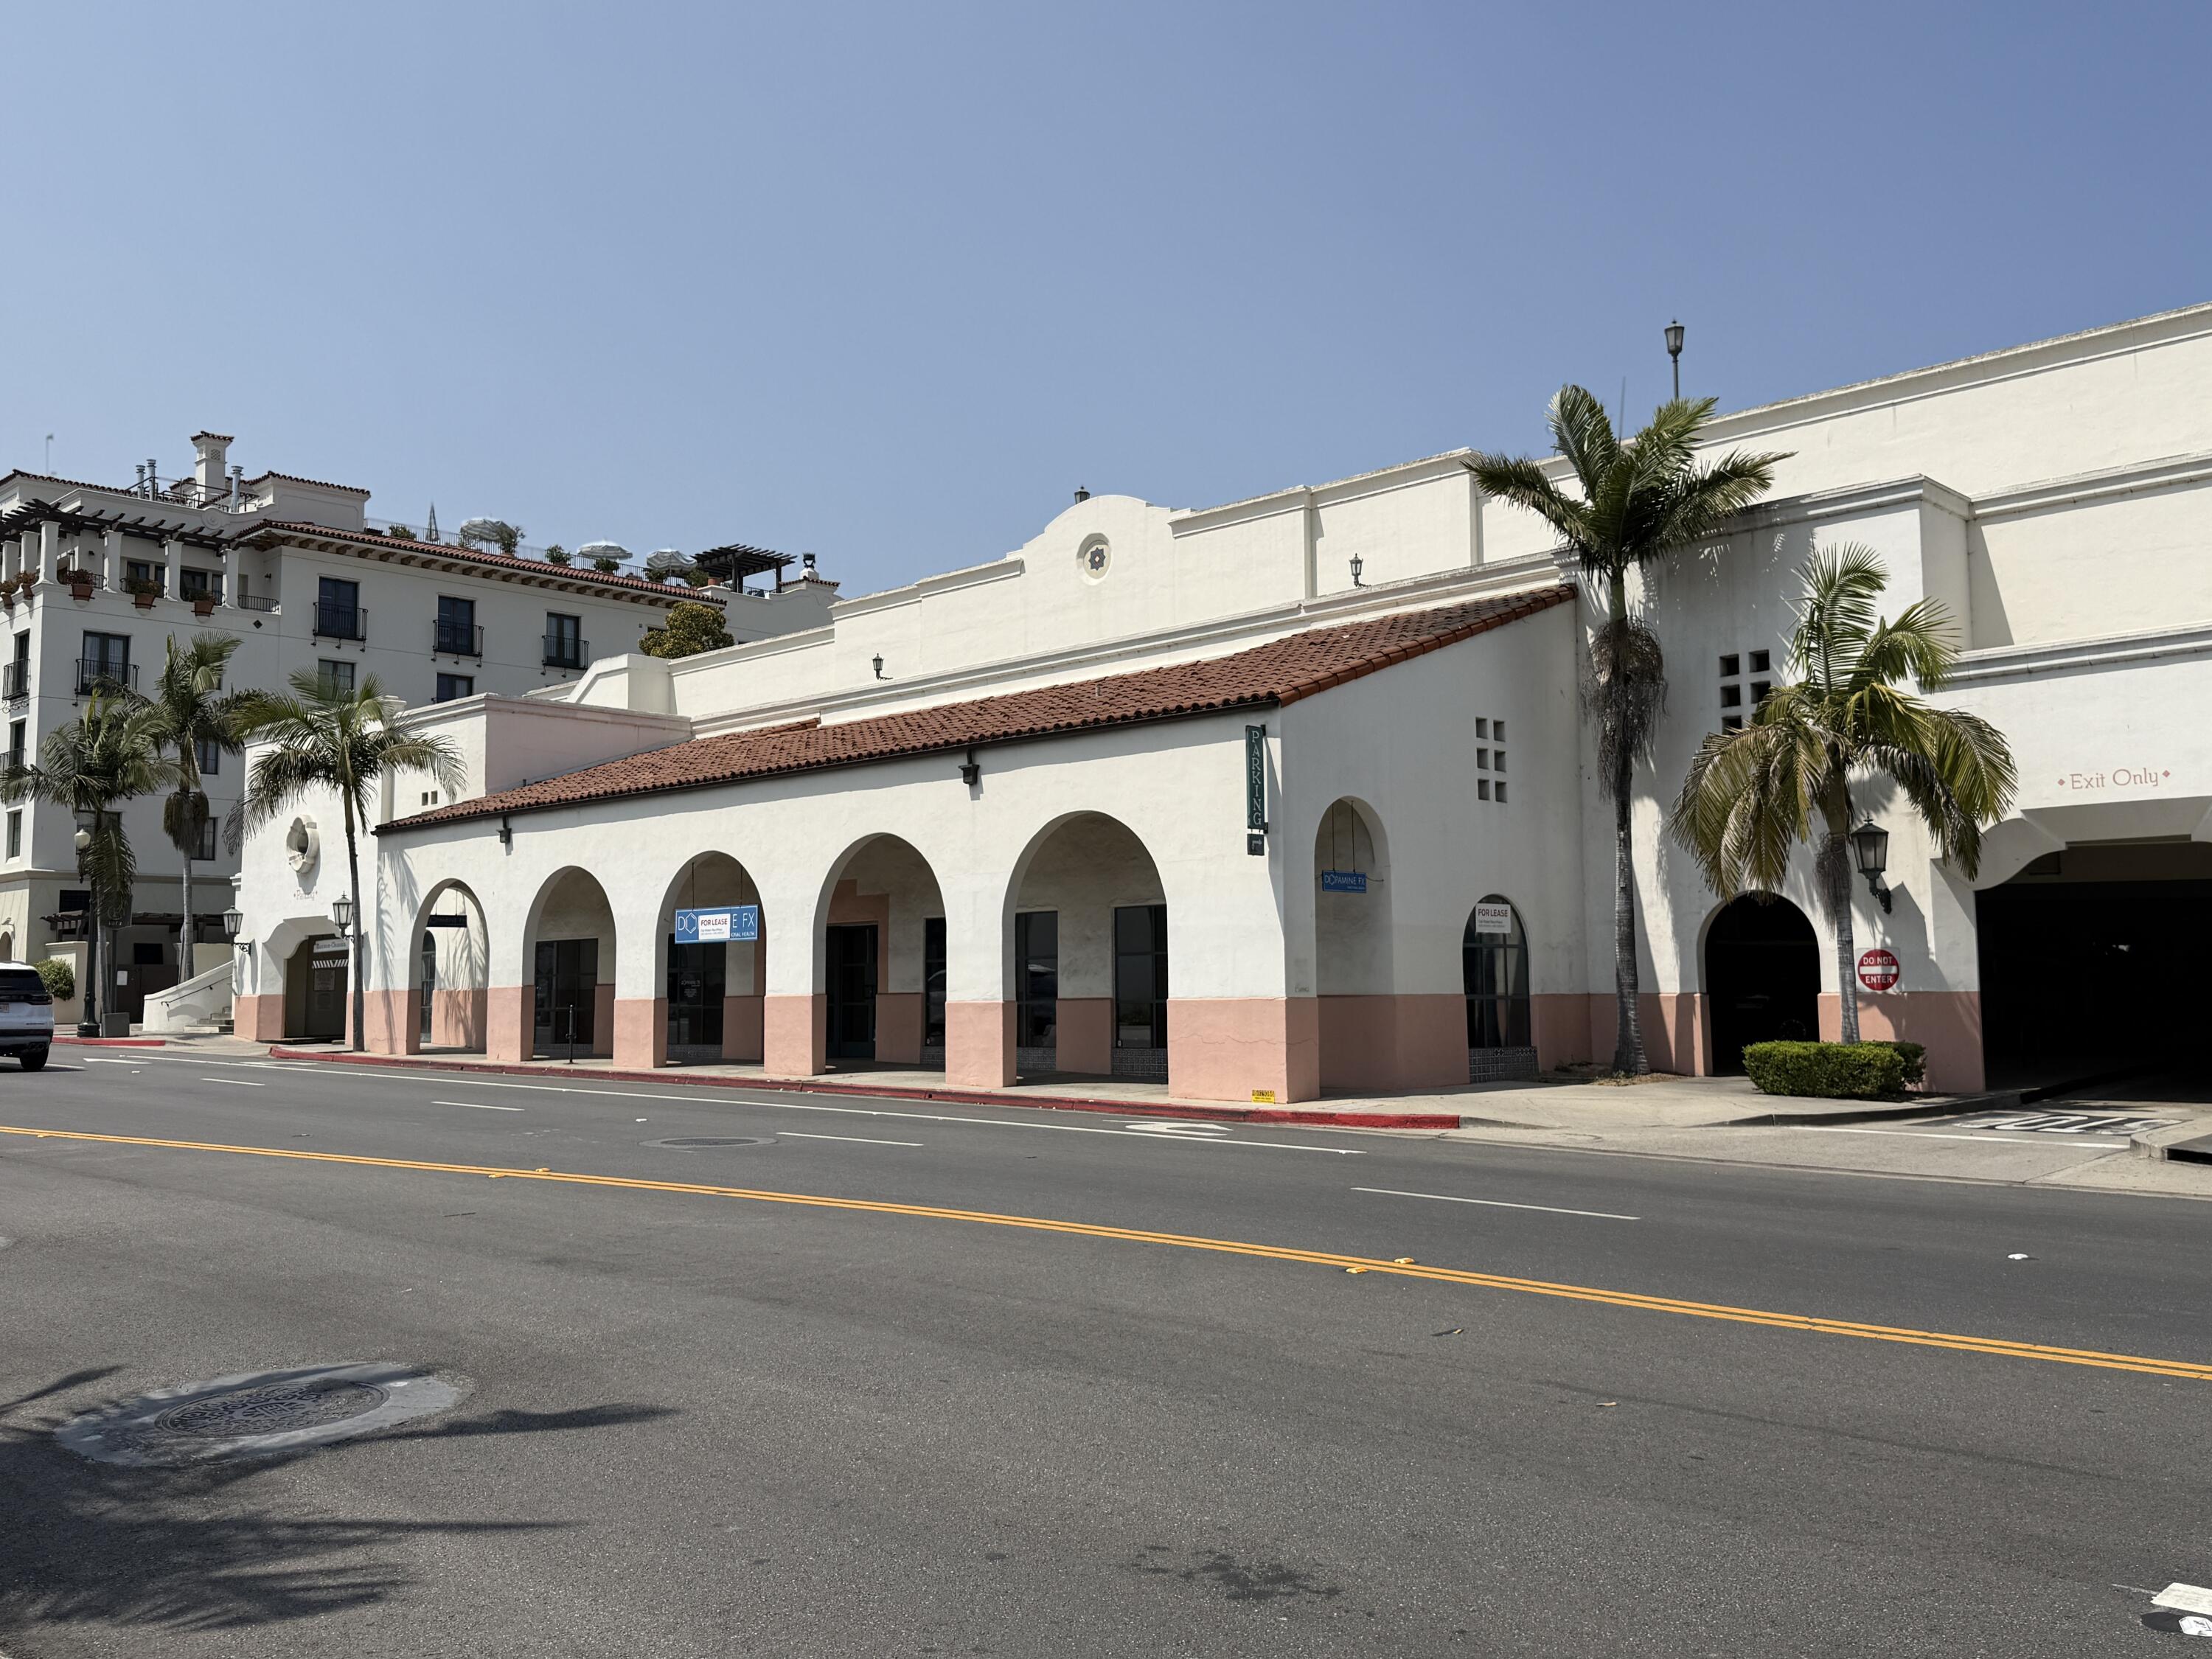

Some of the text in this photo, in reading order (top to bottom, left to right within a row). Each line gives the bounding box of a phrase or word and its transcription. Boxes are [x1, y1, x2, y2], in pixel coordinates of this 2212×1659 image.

[1251, 730, 1262, 826] PARKING
[2069, 768, 2159, 790] Exit Only
[1324, 874, 1365, 886] DOPAMINE FX
[1478, 908, 1508, 917] FOR LEASE
[742, 913, 755, 928] FX
[1863, 956, 1893, 965] DO NOT
[1865, 975, 1893, 984] ENTER
